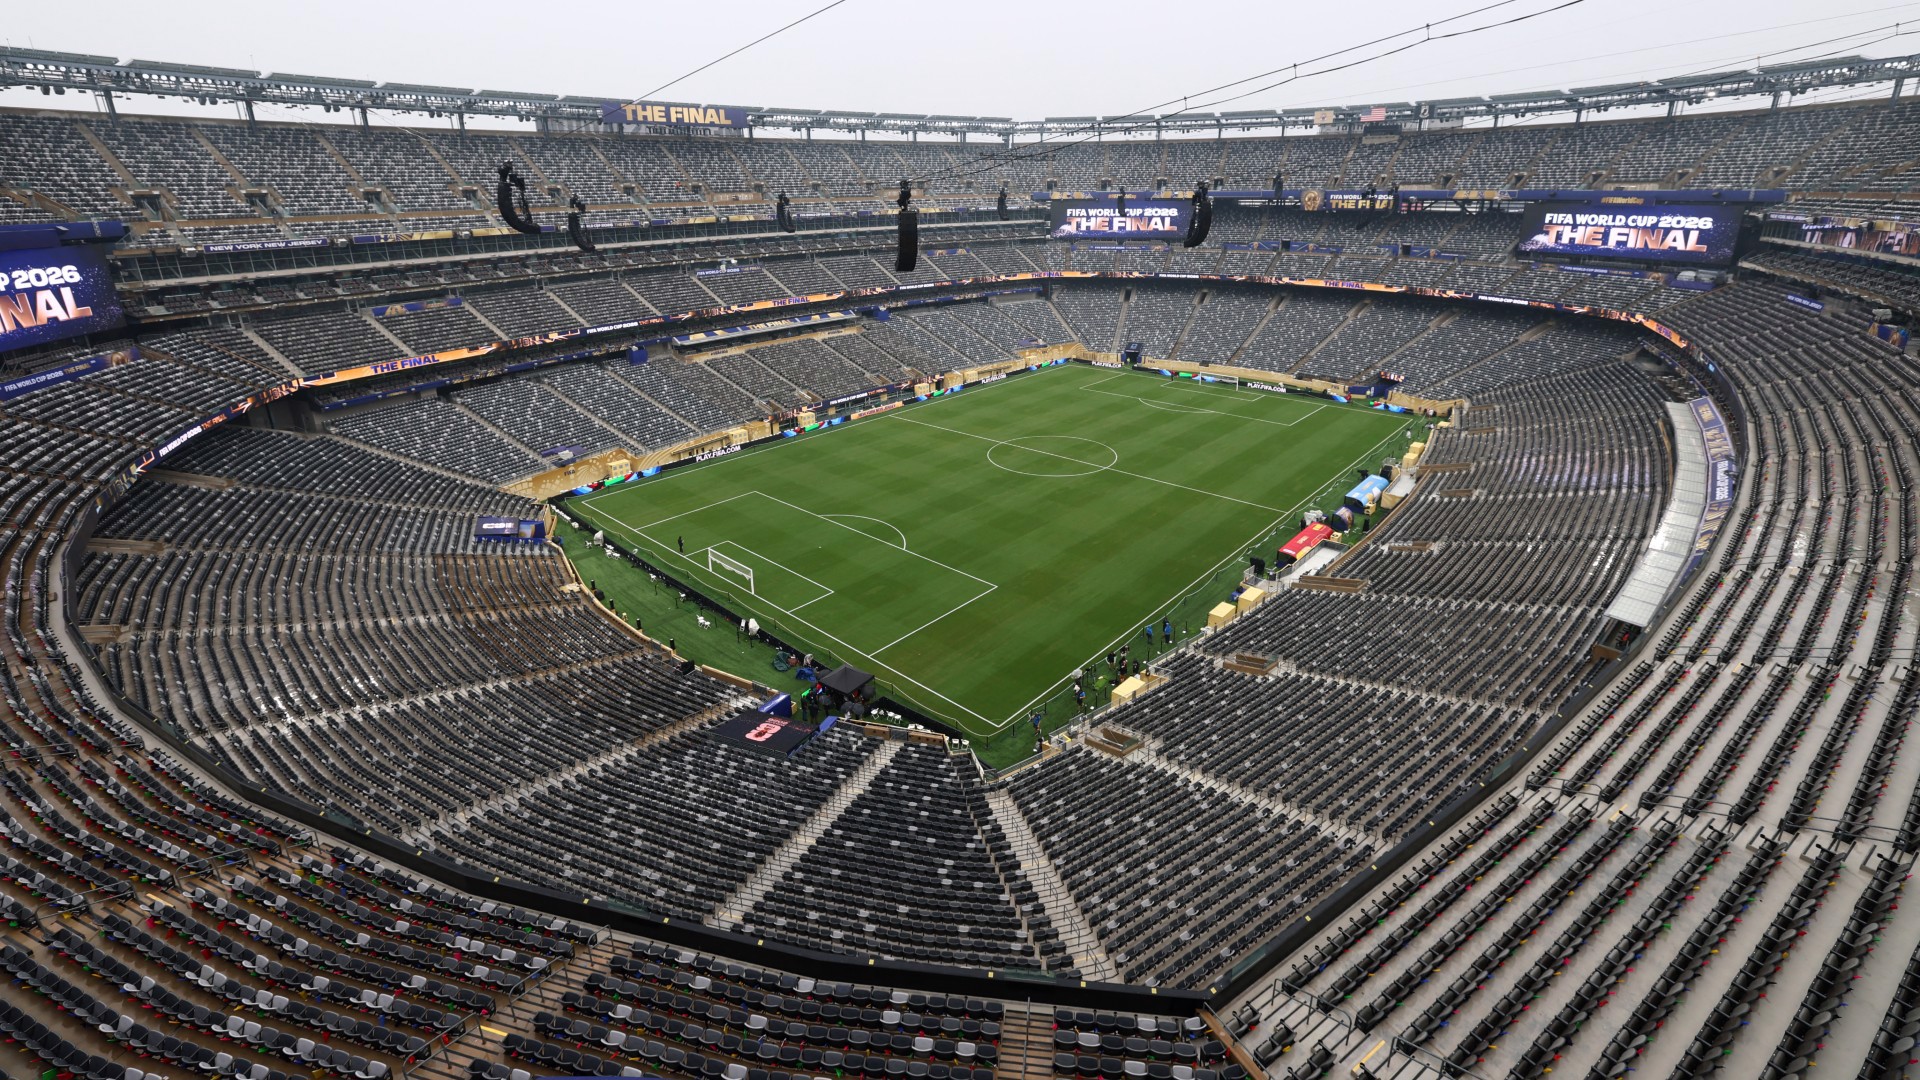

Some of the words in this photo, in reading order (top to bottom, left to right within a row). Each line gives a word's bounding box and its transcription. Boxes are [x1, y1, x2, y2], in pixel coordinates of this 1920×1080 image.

[621, 103, 667, 122] THE
[670, 106, 732, 125] FINAL
[1067, 208, 1087, 217] FIFA
[1087, 208, 1121, 217] WORL
[1143, 207, 1178, 217] 2026
[1331, 200, 1356, 209] THE
[1066, 217, 1109, 231] THE
[1113, 217, 1178, 231] FINAL
[1544, 213, 1573, 225] FIFA
[1575, 214, 1626, 226] WORLD
[1627, 215, 1658, 227] CUP
[1658, 215, 1713, 230] 2026
[264, 241, 287, 249] NEW
[1543, 225, 1605, 246] THE
[1607, 227, 1708, 253] FINAL
[12, 265, 82, 290] 2026
[1323, 280, 1339, 288] THE
[1341, 281, 1365, 289] FINAL
[788, 296, 809, 305] FINAL
[0, 286, 93, 333] NAL
[371, 361, 399, 374] THE
[400, 355, 439, 369] FINAL
[4, 384, 17, 393] FIFA
[17, 378, 36, 390] WORLD
[36, 375, 46, 384] CUP
[46, 370, 64, 380] 2026
[1247, 382, 1287, 393] PLAY.FIFA.COM
[695, 445, 741, 463] PLAY.FIFA.COM
